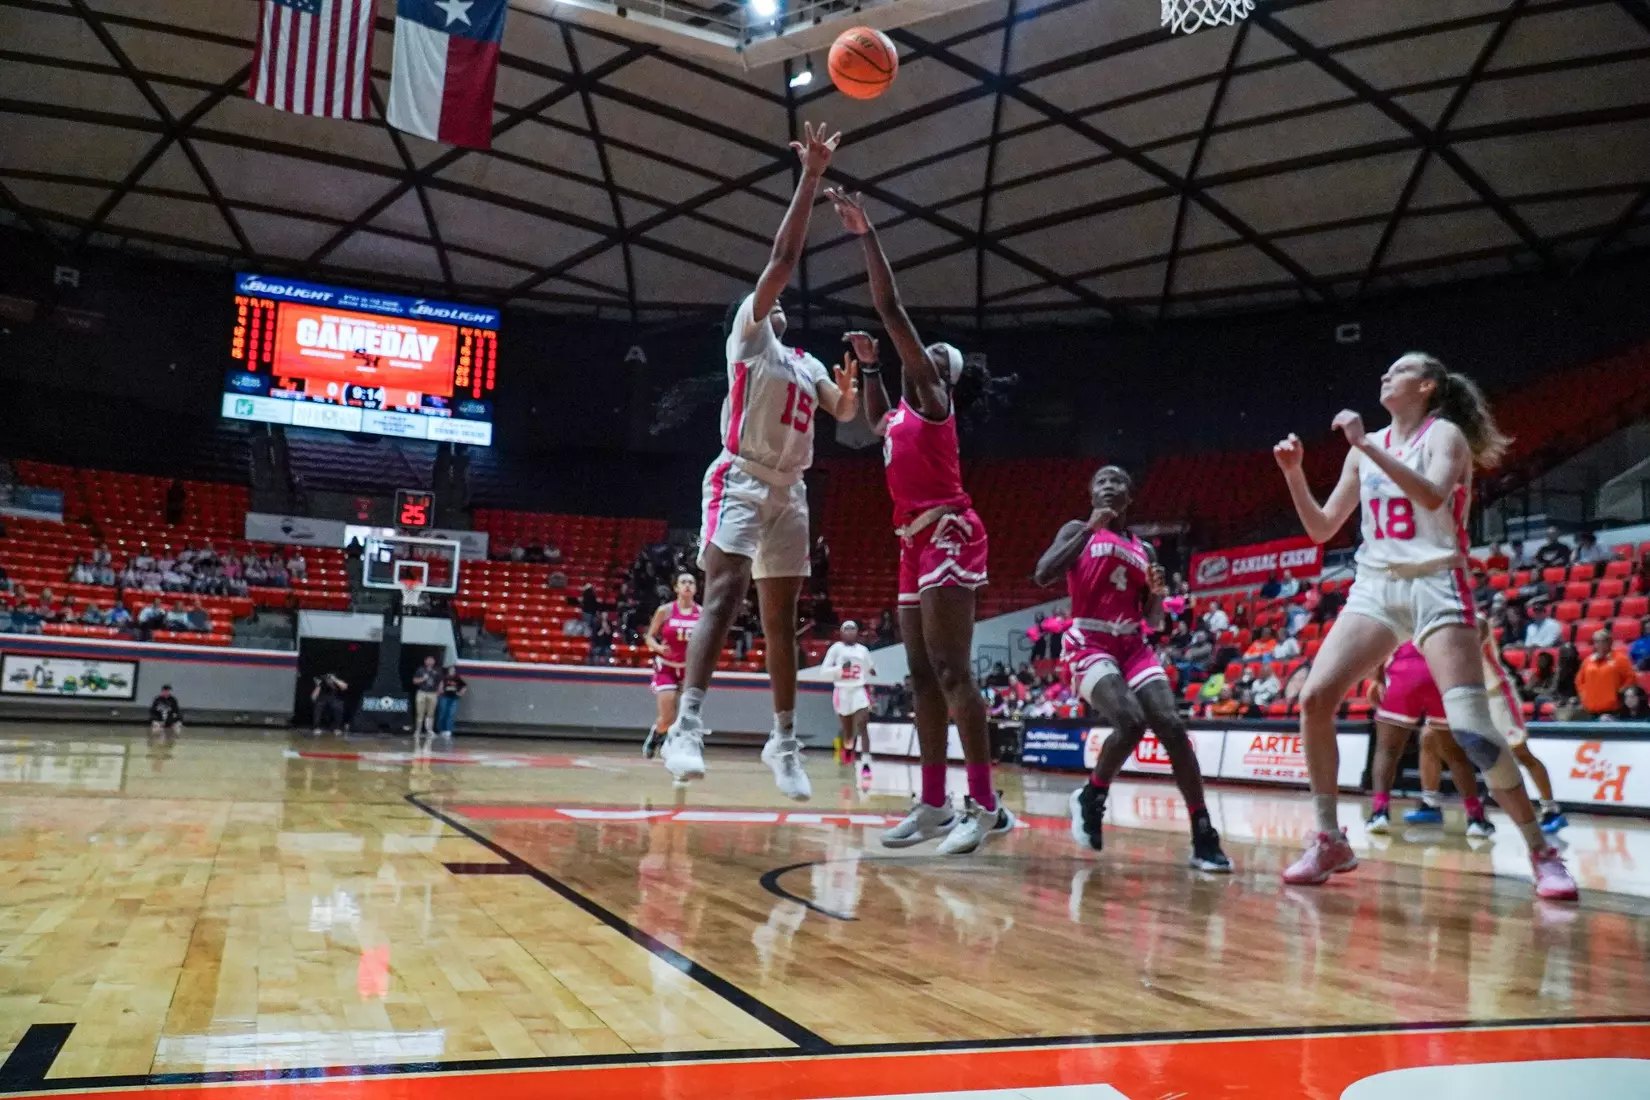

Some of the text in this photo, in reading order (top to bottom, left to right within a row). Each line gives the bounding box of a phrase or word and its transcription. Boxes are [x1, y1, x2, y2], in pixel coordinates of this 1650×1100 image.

[285, 285, 335, 301] LIGHT
[450, 309, 496, 323] LIGHT
[296, 316, 440, 362] GAMEDAY
[624, 345, 648, 363] A
[326, 381, 339, 397] 0
[351, 385, 383, 402] 9:14
[405, 391, 418, 406] 0
[781, 381, 814, 434] 15
[401, 503, 426, 525] 25
[1369, 497, 1417, 540] 18
[1109, 564, 1129, 593] 4
[1138, 740, 1171, 760] H-E
[1249, 735, 1305, 754] ARTE
